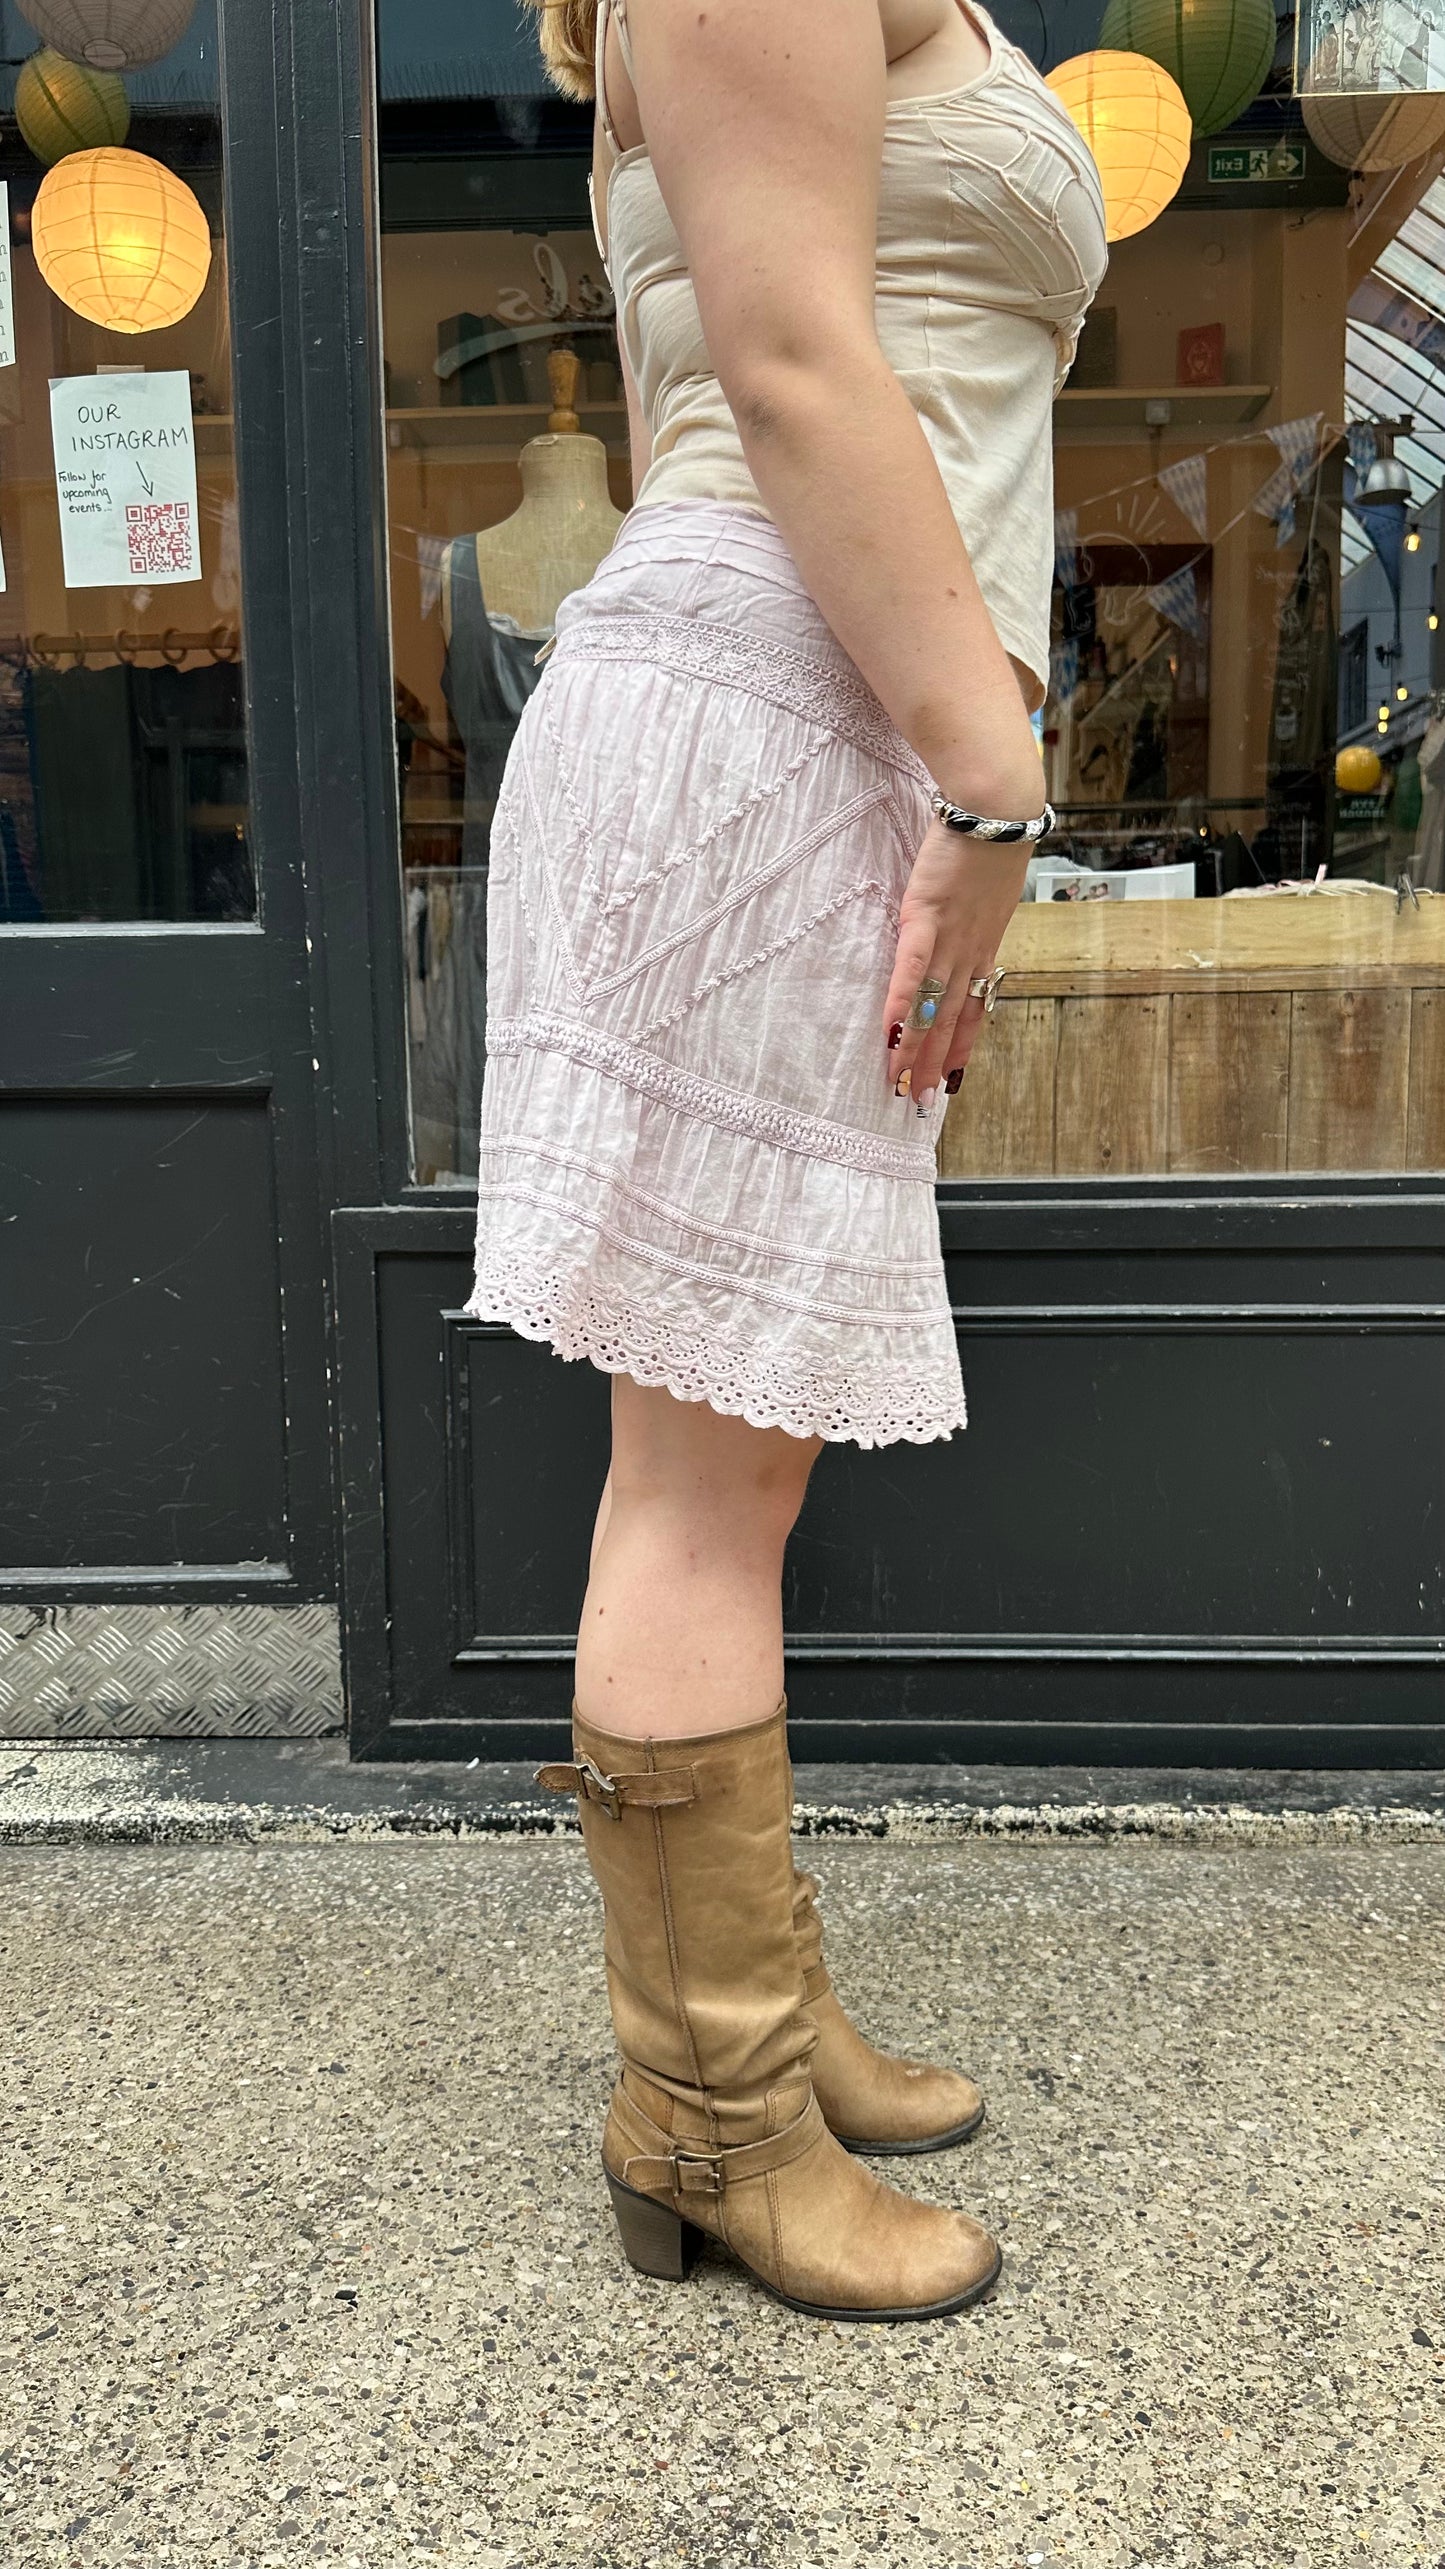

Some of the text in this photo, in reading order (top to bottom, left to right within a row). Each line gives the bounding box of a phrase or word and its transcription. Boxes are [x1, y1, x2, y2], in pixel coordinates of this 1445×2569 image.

[78, 403, 121, 424] OUR
[72, 427, 188, 452] INSTAGRAM
[58, 470, 107, 489] Follow for
[62, 488, 112, 504] upcoming
